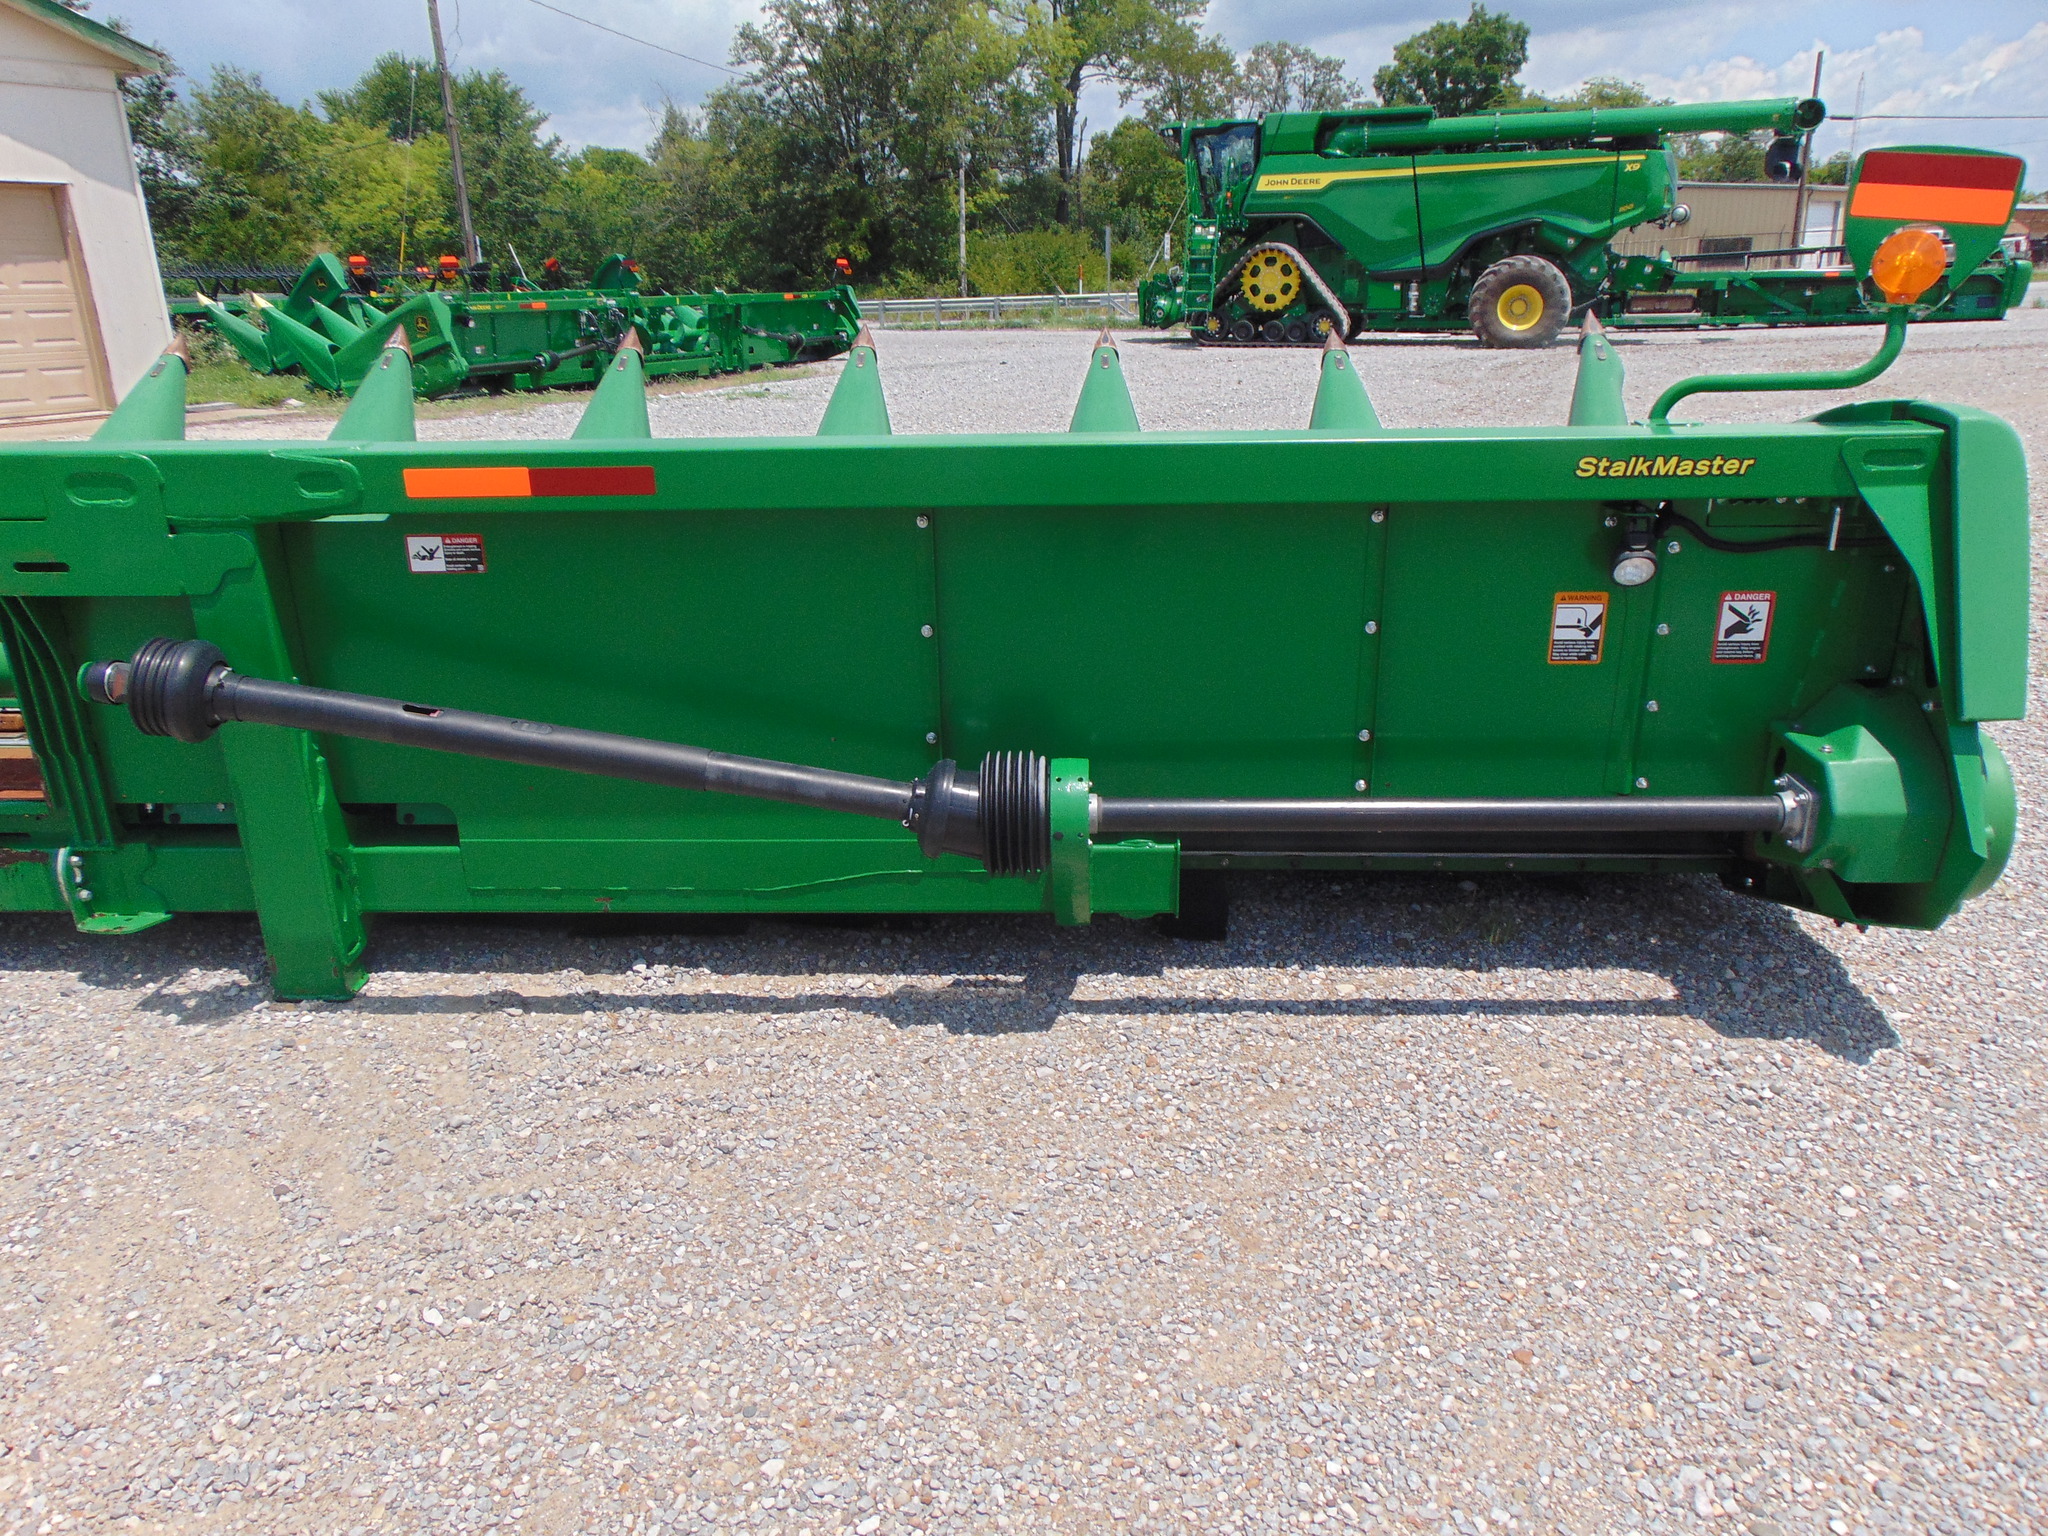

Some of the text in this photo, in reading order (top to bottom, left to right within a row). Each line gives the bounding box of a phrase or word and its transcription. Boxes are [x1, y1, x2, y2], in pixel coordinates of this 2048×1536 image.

[1624, 163, 1641, 172] X9
[1290, 177, 1321, 185] DEERE
[1575, 455, 1755, 478] StalkMaster
